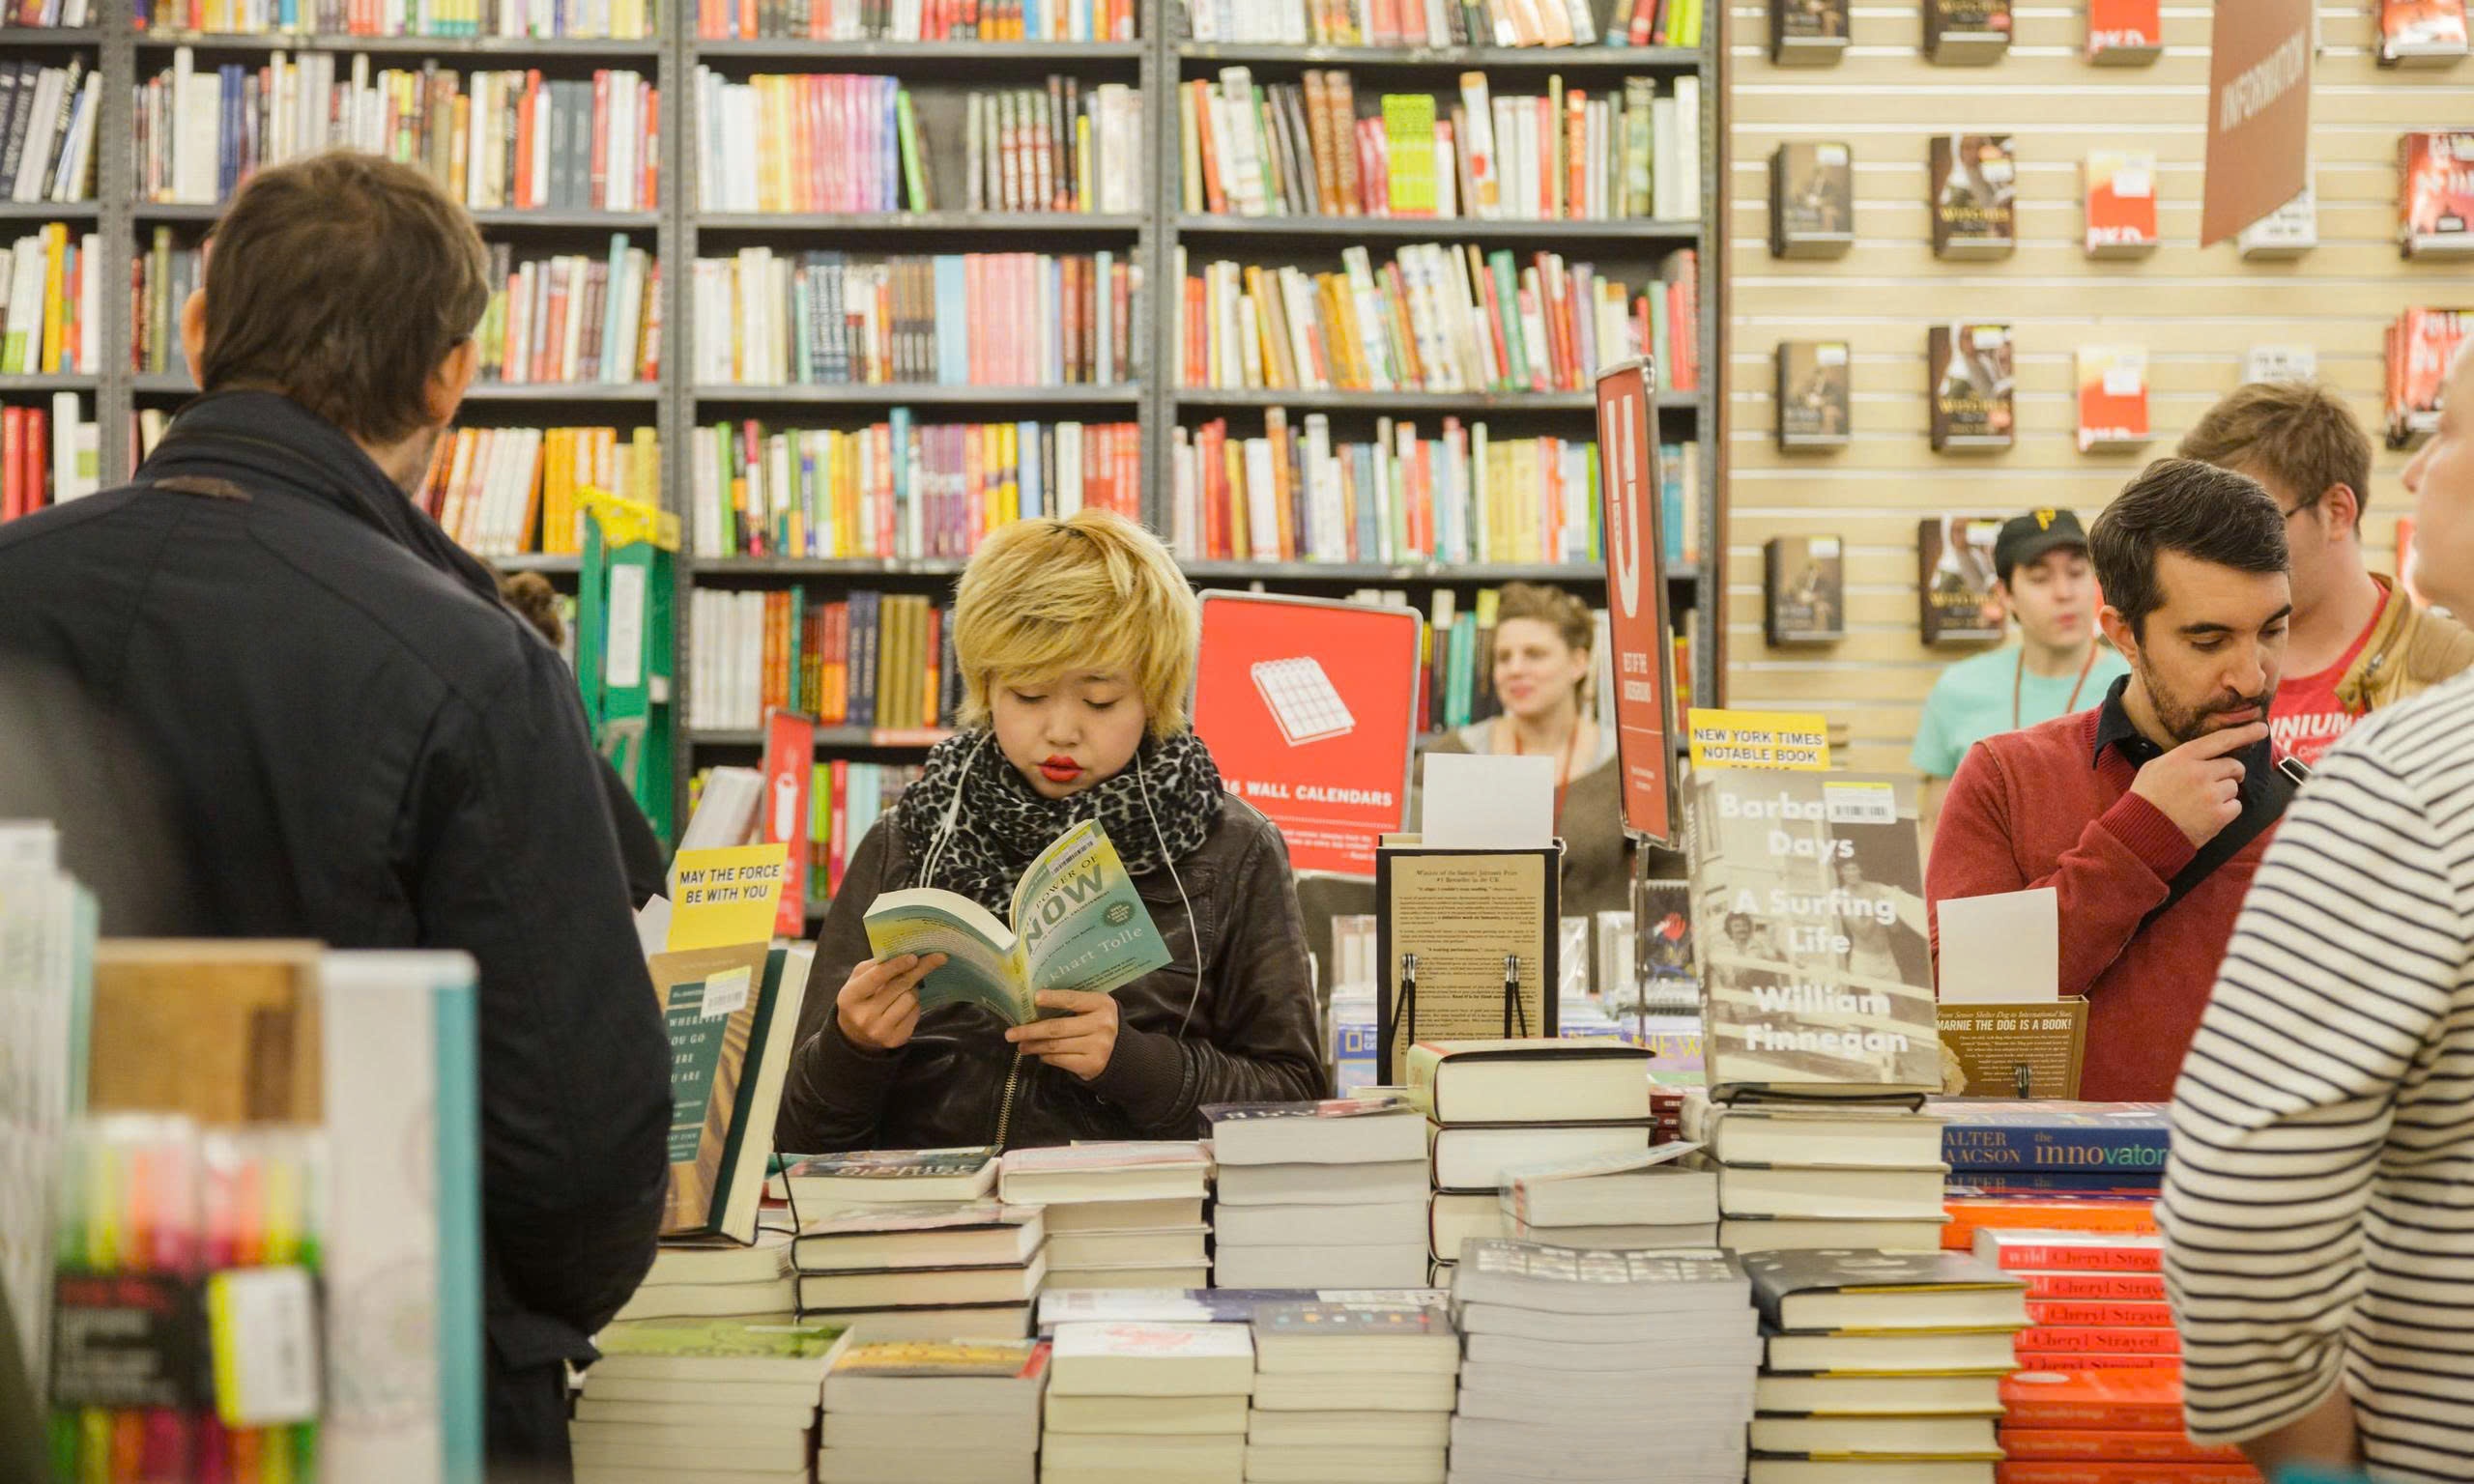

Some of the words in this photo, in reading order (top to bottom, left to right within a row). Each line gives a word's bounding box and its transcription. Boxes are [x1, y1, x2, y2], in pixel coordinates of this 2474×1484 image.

[1694, 728, 1727, 741] NEW
[1732, 730, 1771, 743] YORK
[1777, 731, 1824, 746] TIMES
[1703, 747, 1770, 761] NOTABLE
[1776, 749, 1817, 763] BOOK
[1247, 781, 1290, 800] WALL
[1295, 785, 1393, 808] CALENDARS
[1769, 829, 1856, 866] Days
[679, 870, 705, 884] MAY
[710, 868, 734, 882] THE
[738, 865, 781, 880] FORCE
[686, 890, 703, 904] BE
[707, 887, 738, 902] WITH
[743, 885, 768, 899] YOU
[1036, 870, 1077, 910] POWER
[1025, 863, 1105, 957] NOW
[1737, 888, 1760, 914] A
[1769, 887, 1898, 926] Surfing
[1098, 925, 1143, 953] Tolle
[1788, 926, 1852, 954] Life
[1752, 985, 1891, 1015] William
[1936, 1019, 1972, 1032] MARNIE
[1975, 1019, 1995, 1031] THE
[1997, 1019, 2017, 1031] DOG
[2020, 1019, 2029, 1031] IS
[2031, 1019, 2040, 1031] A
[2042, 1018, 2073, 1030] BOOK!
[689, 1033, 705, 1044] GO
[1743, 1023, 1909, 1059] Finnegan
[2034, 1132, 2053, 1143] the
[2008, 1247, 2047, 1264] wild
[2052, 1252, 2109, 1269] Cheryl
[2056, 1280, 2111, 1298] Cheryl
[2050, 1306, 2106, 1325] Cheryl
[2032, 1332, 2088, 1351] Cheryl
[2096, 1333, 2159, 1353] Strayed
